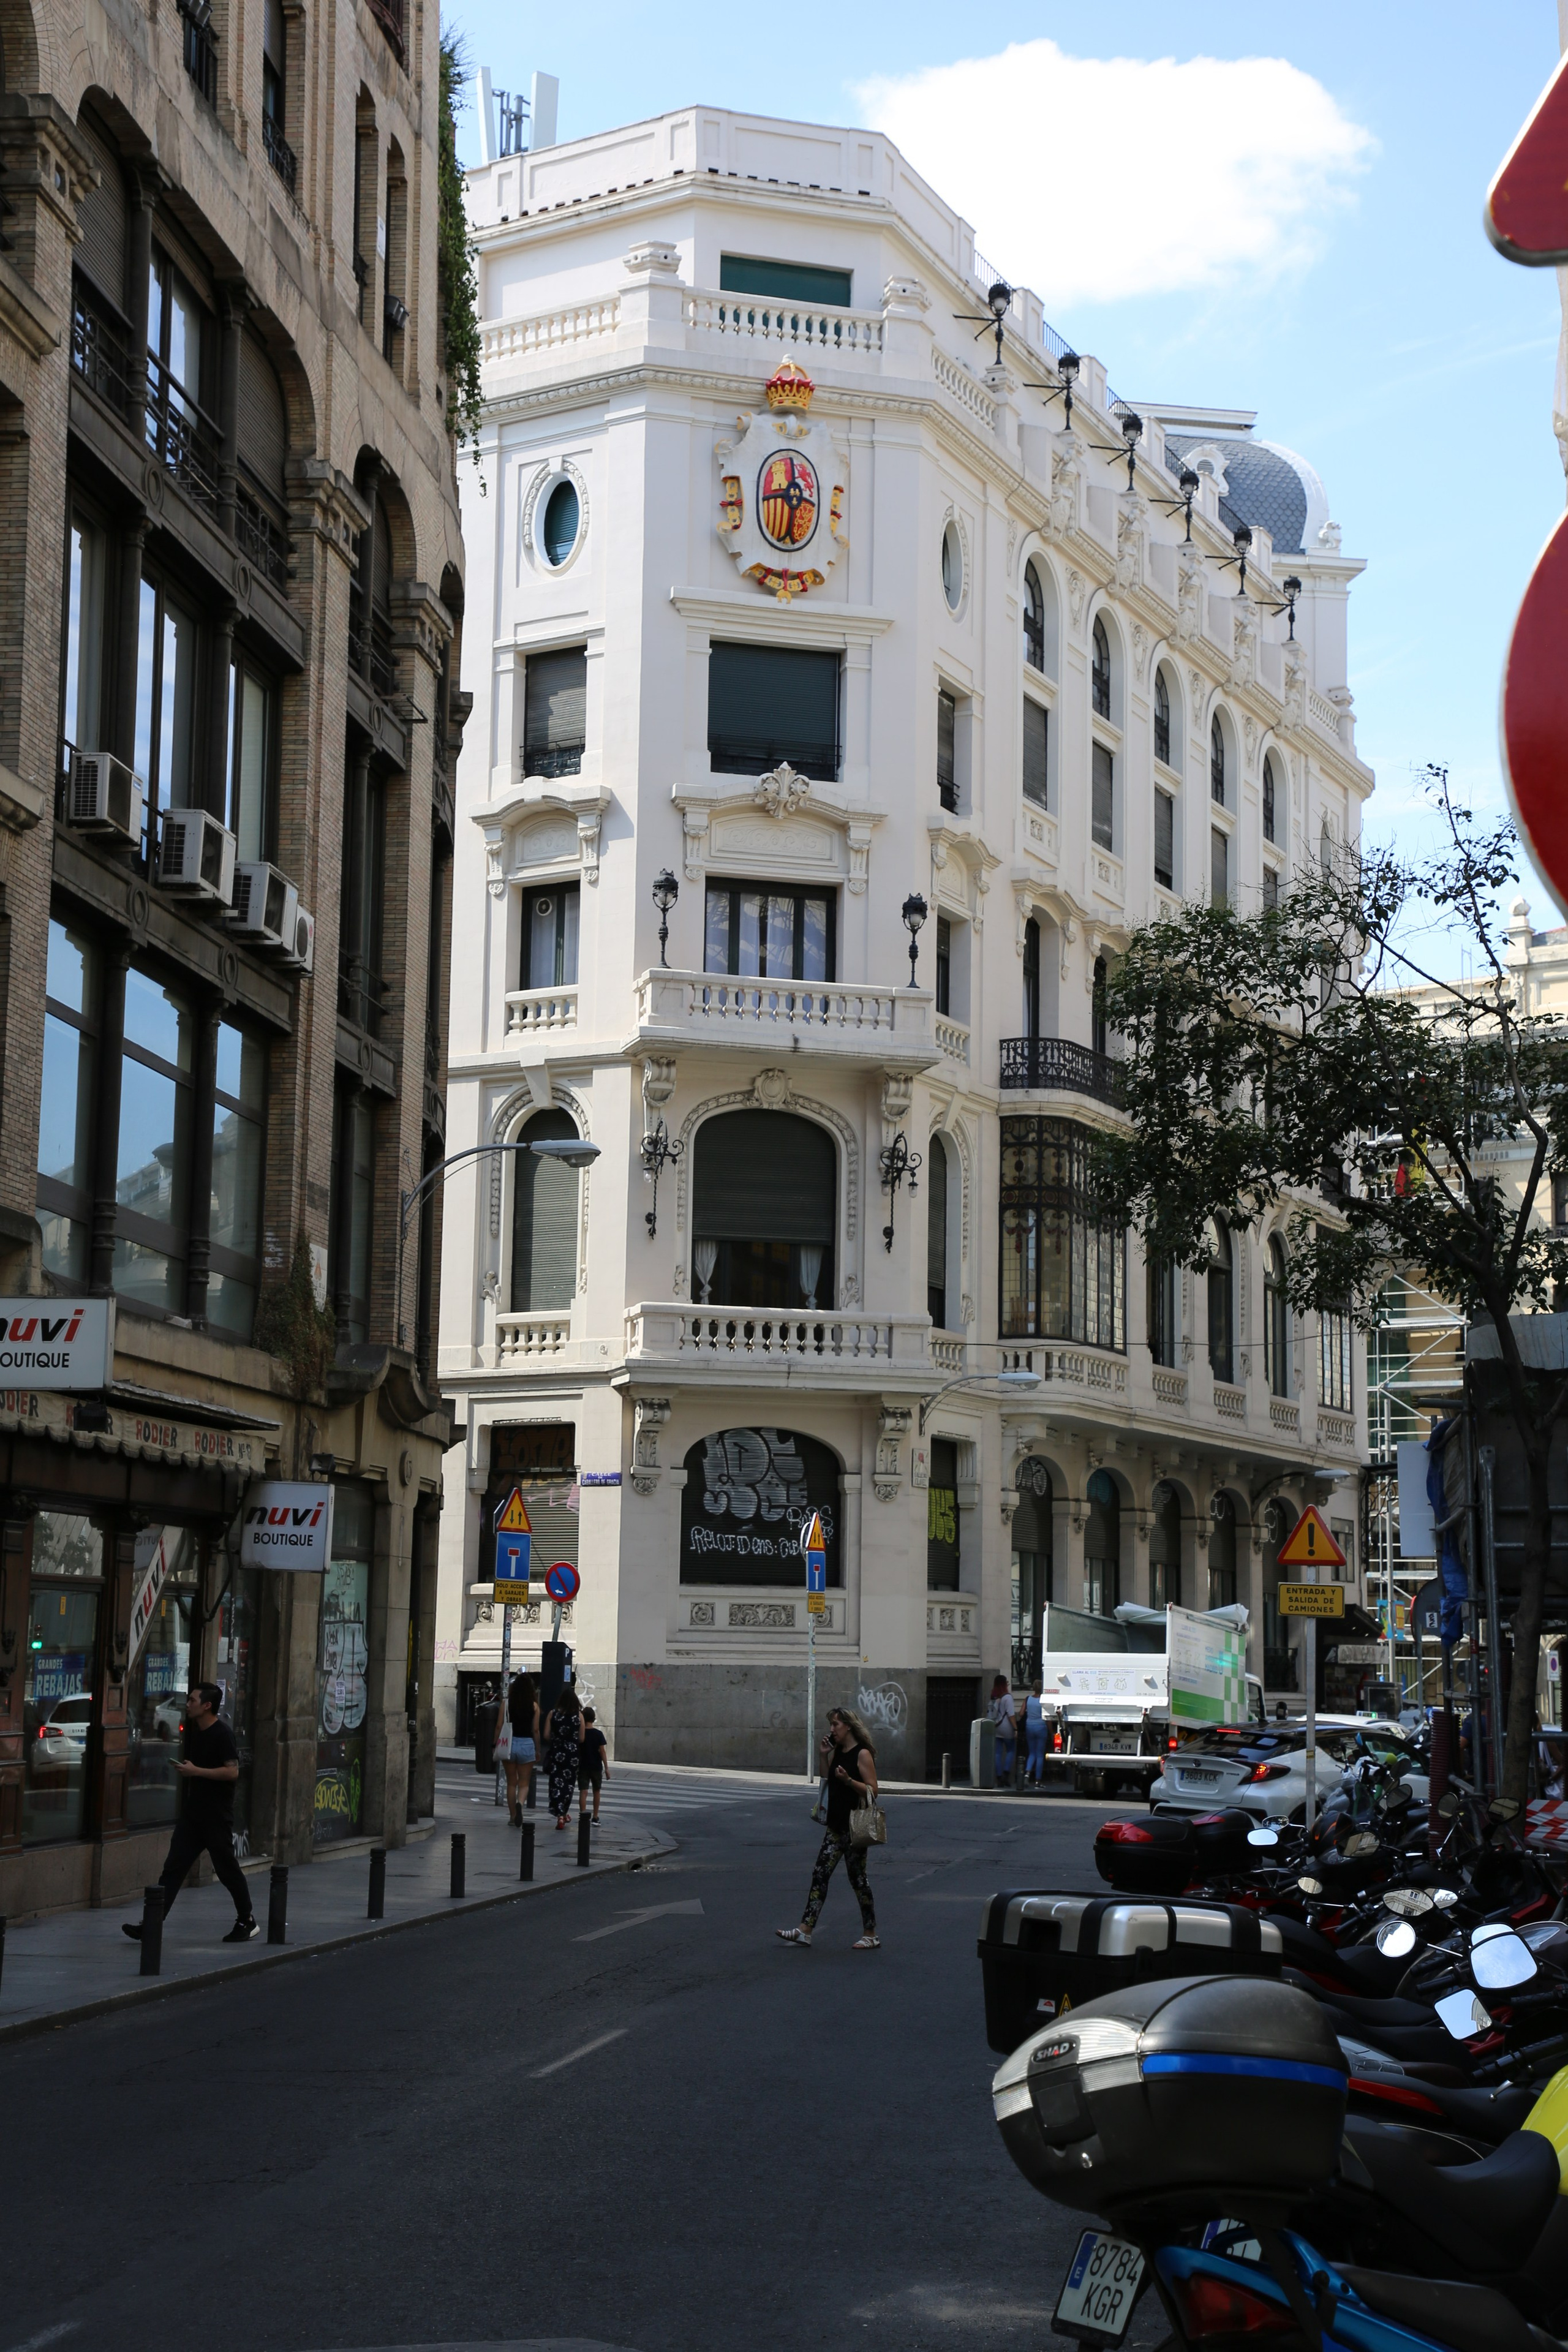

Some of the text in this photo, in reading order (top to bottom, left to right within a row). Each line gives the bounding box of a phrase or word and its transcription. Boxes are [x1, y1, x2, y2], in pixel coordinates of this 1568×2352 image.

[0, 1309, 85, 1343] uvi
[0, 1352, 70, 1368] OUTIQUE
[136, 1420, 178, 1448] RODIER
[194, 1431, 235, 1457] RODIER
[245, 1502, 325, 1528] nuvi
[254, 1532, 313, 1546] BOUTIQUE
[134, 1535, 167, 1642] nuvi
[148, 1657, 168, 1667] GRANDES
[565, 1648, 570, 1657] P
[38, 1659, 63, 1670] GRANDES
[36, 1673, 82, 1697] REBAJAS
[1185, 1771, 1202, 1781] 3603
[1204, 1773, 1218, 1782] KCK
[1036, 2043, 1070, 2061] SHAD
[1074, 2267, 1082, 2279] E
[1090, 2243, 1142, 2286] 8784
[1080, 2282, 1123, 2325] KGR
